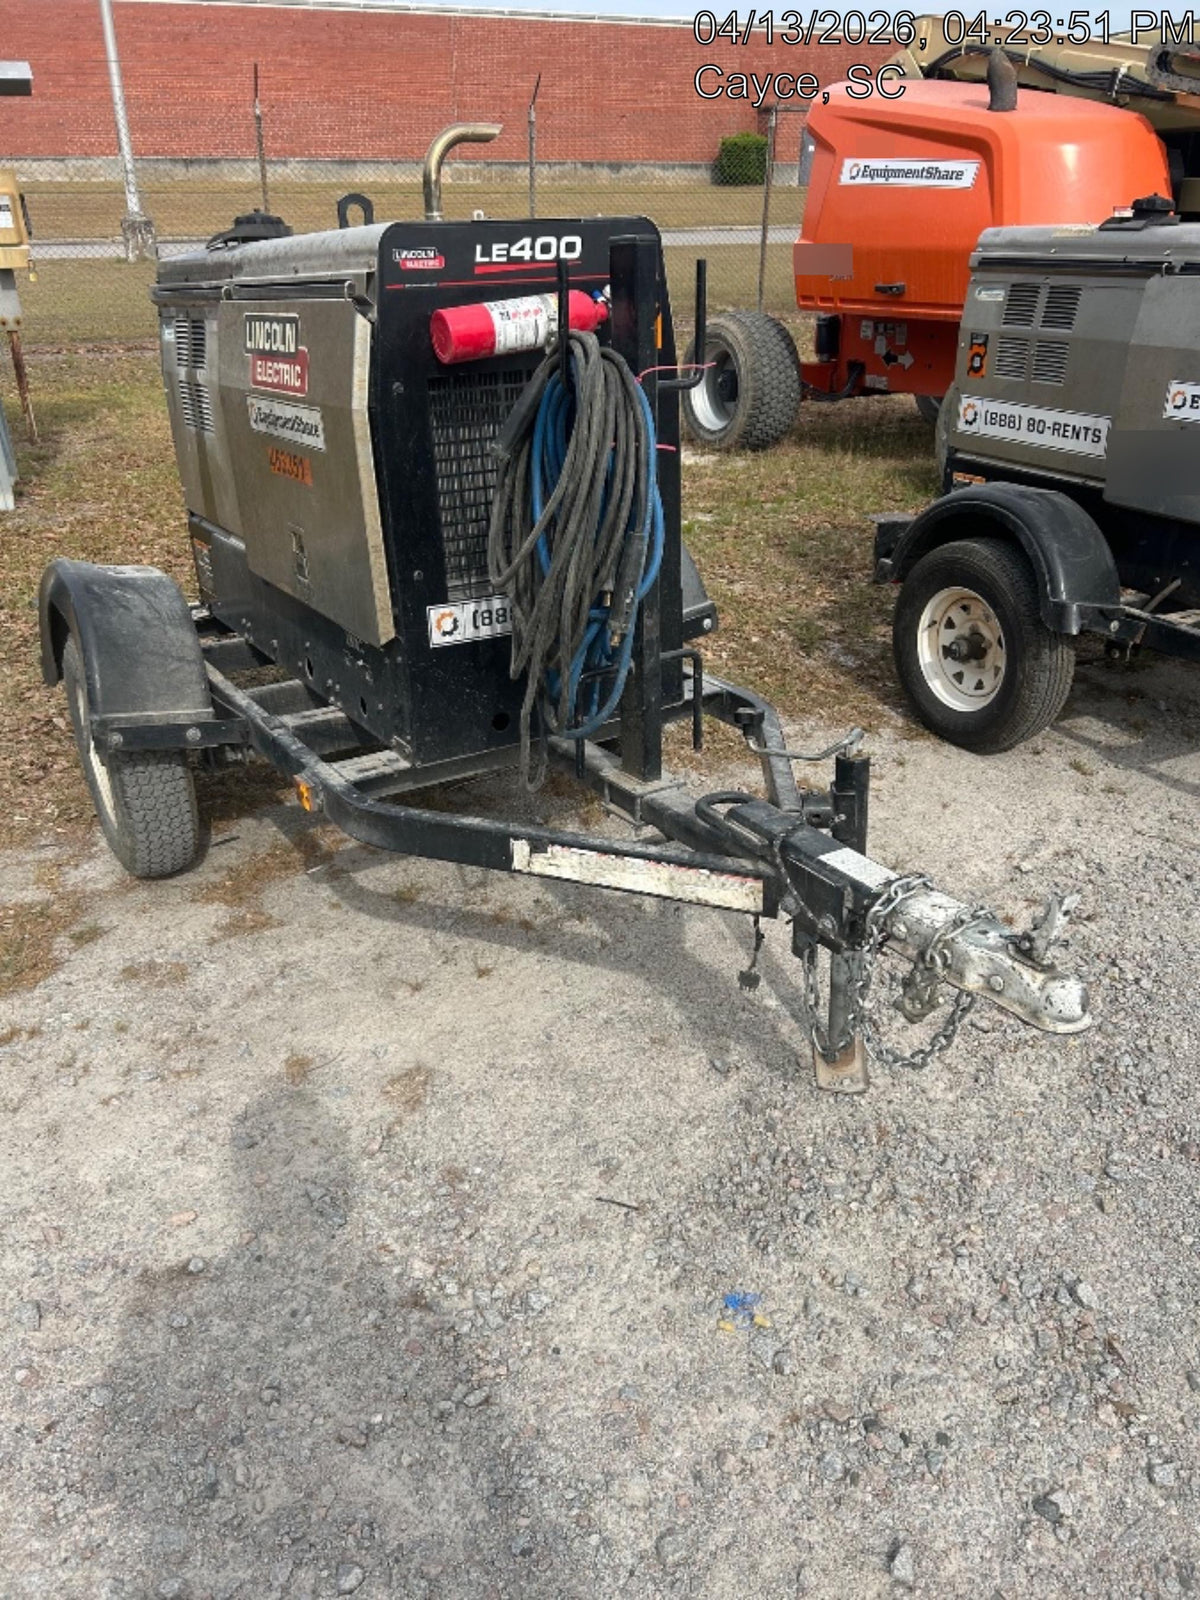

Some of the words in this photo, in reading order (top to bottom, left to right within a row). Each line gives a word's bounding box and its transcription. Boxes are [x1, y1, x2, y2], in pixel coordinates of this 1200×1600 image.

[861, 163, 965, 182] EquipmentShare
[474, 235, 582, 263] LE400
[245, 320, 297, 354] LINCOLN
[255, 360, 302, 388] ELECTRIC
[984, 409, 1023, 432] (888)
[1026, 417, 1103, 445] 80-RENTS
